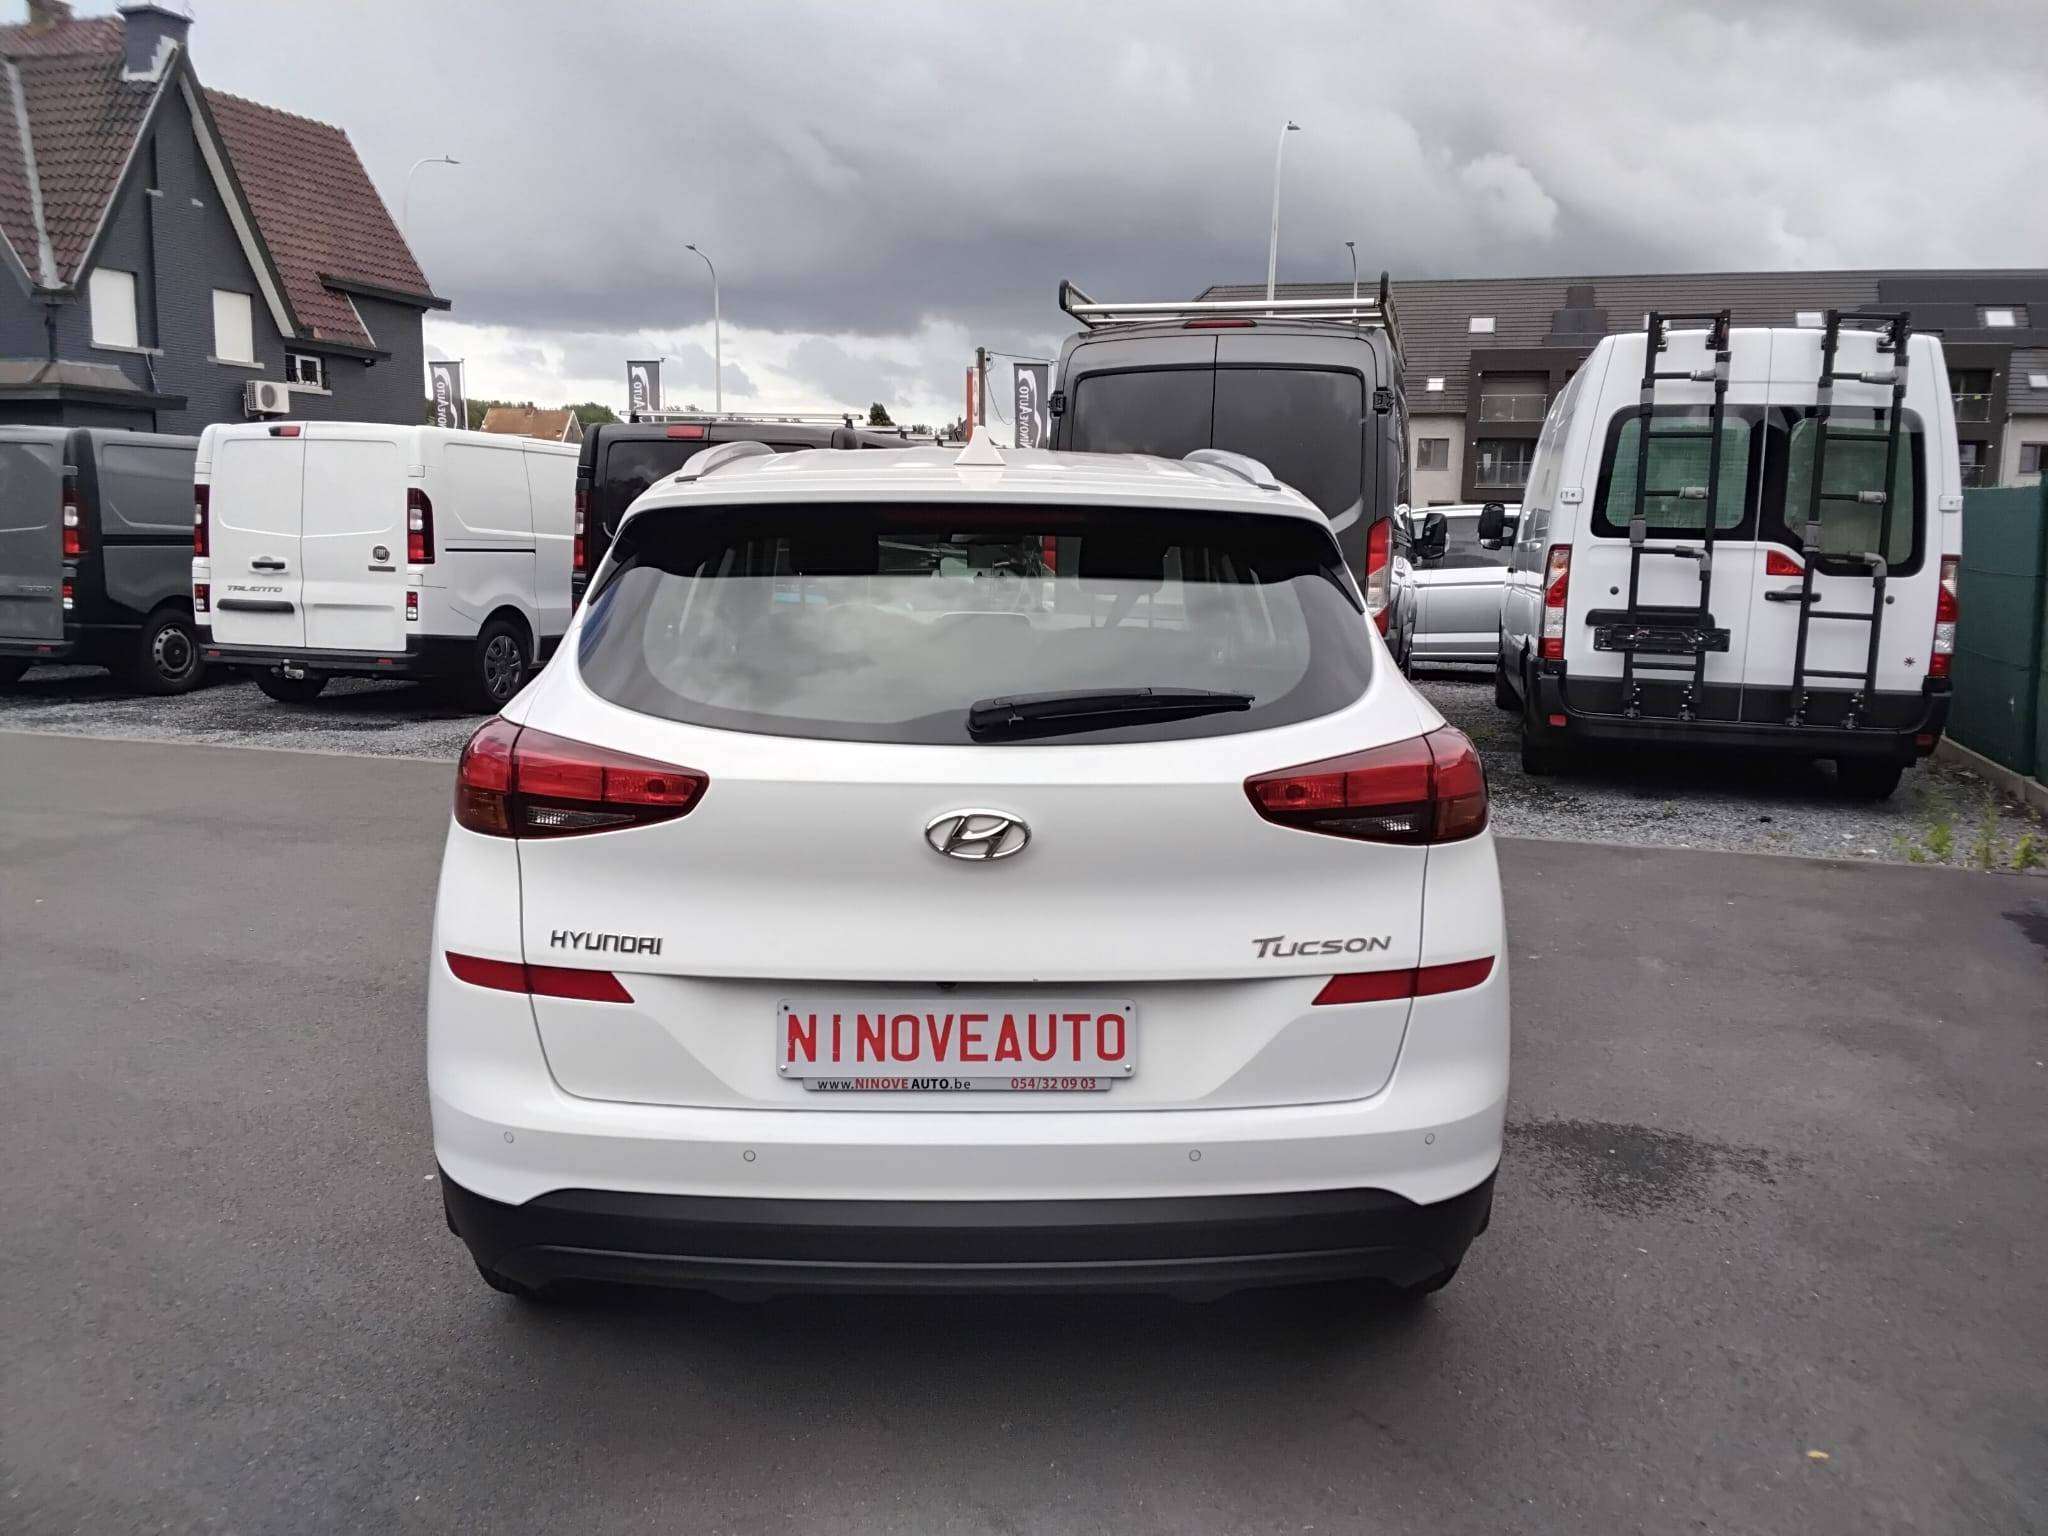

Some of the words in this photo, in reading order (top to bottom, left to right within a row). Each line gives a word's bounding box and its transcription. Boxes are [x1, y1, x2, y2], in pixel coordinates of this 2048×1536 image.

[227, 585, 283, 593] TALENTO
[550, 930, 663, 955] HYUNDAI
[1252, 936, 1391, 958] TUCSON
[1011, 1078, 1058, 1090] 054/32
[1061, 1078, 1077, 1089] 09
[1080, 1078, 1096, 1089] 03
